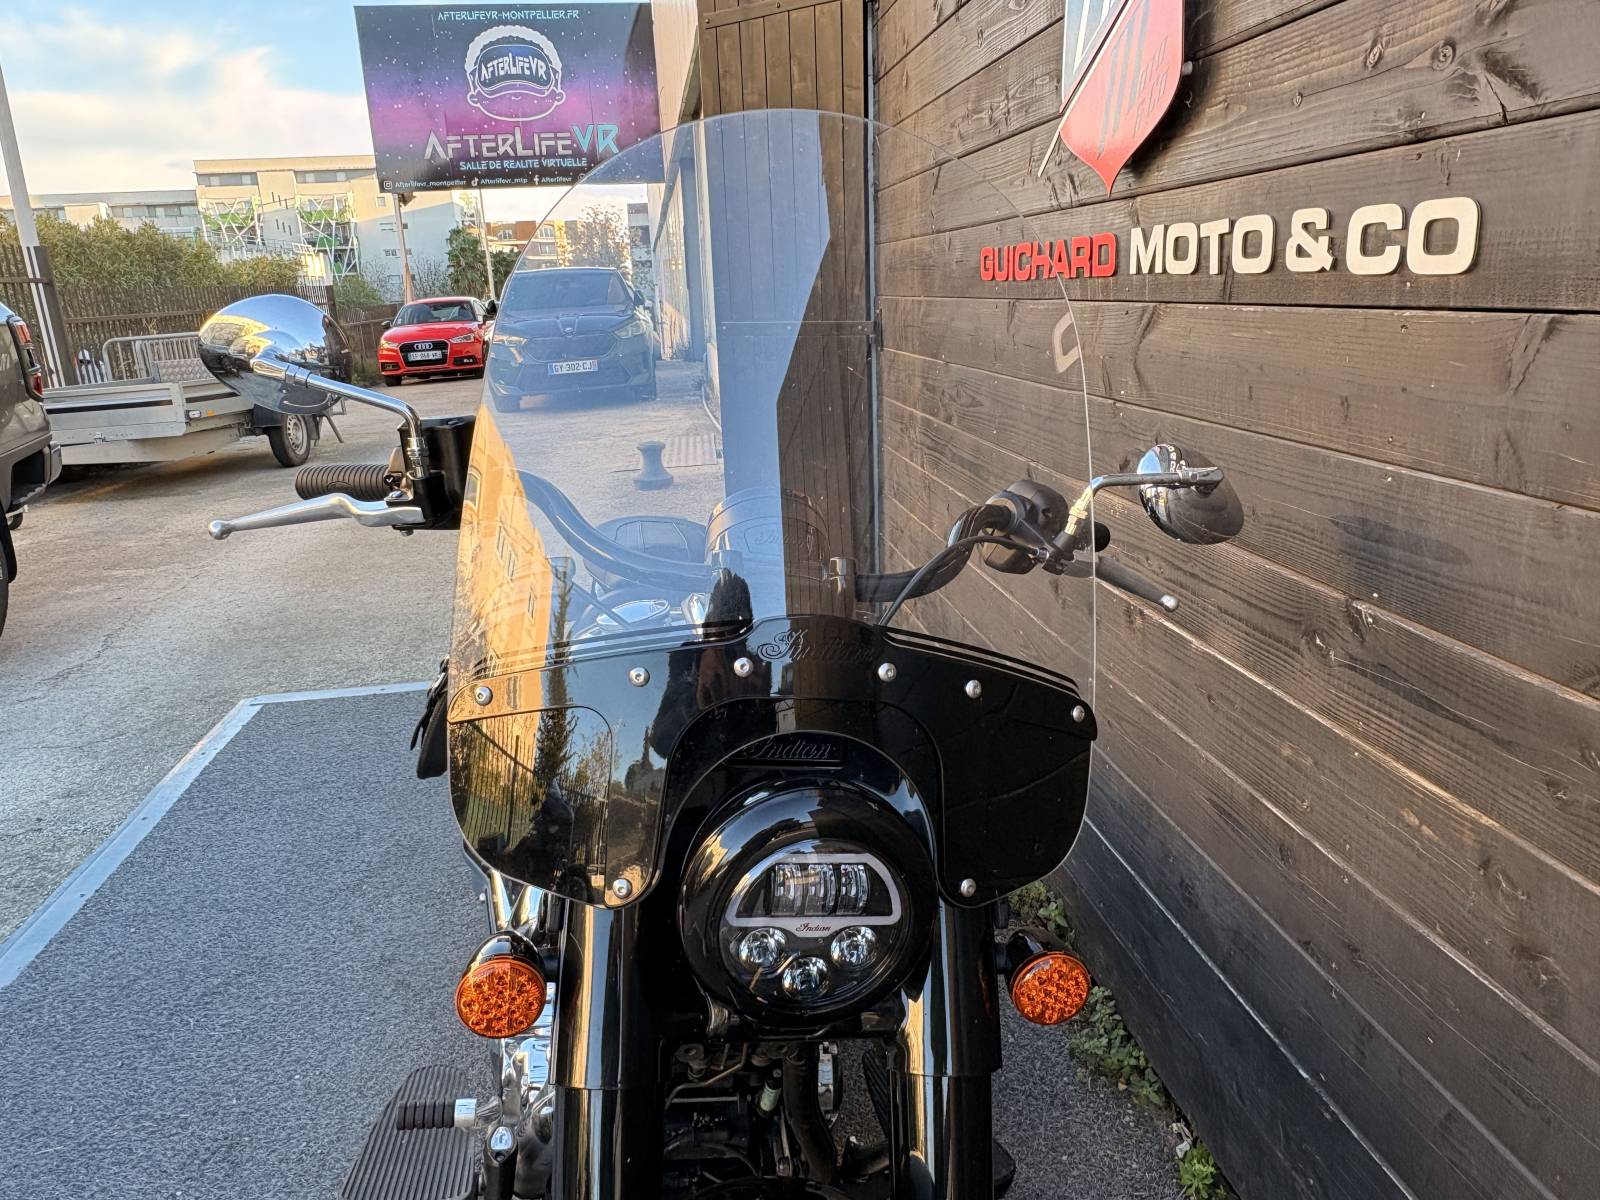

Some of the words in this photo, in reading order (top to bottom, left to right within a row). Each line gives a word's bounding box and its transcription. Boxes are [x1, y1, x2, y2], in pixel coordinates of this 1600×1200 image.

[460, 160, 488, 170] SALLE
[489, 160, 502, 169] DE
[541, 158, 587, 167] VIRTUELLE
[980, 232, 1118, 281] GUICHARD
[1129, 213, 1276, 275] MOTO
[1285, 207, 1335, 272] &
[1346, 196, 1481, 276] CO
